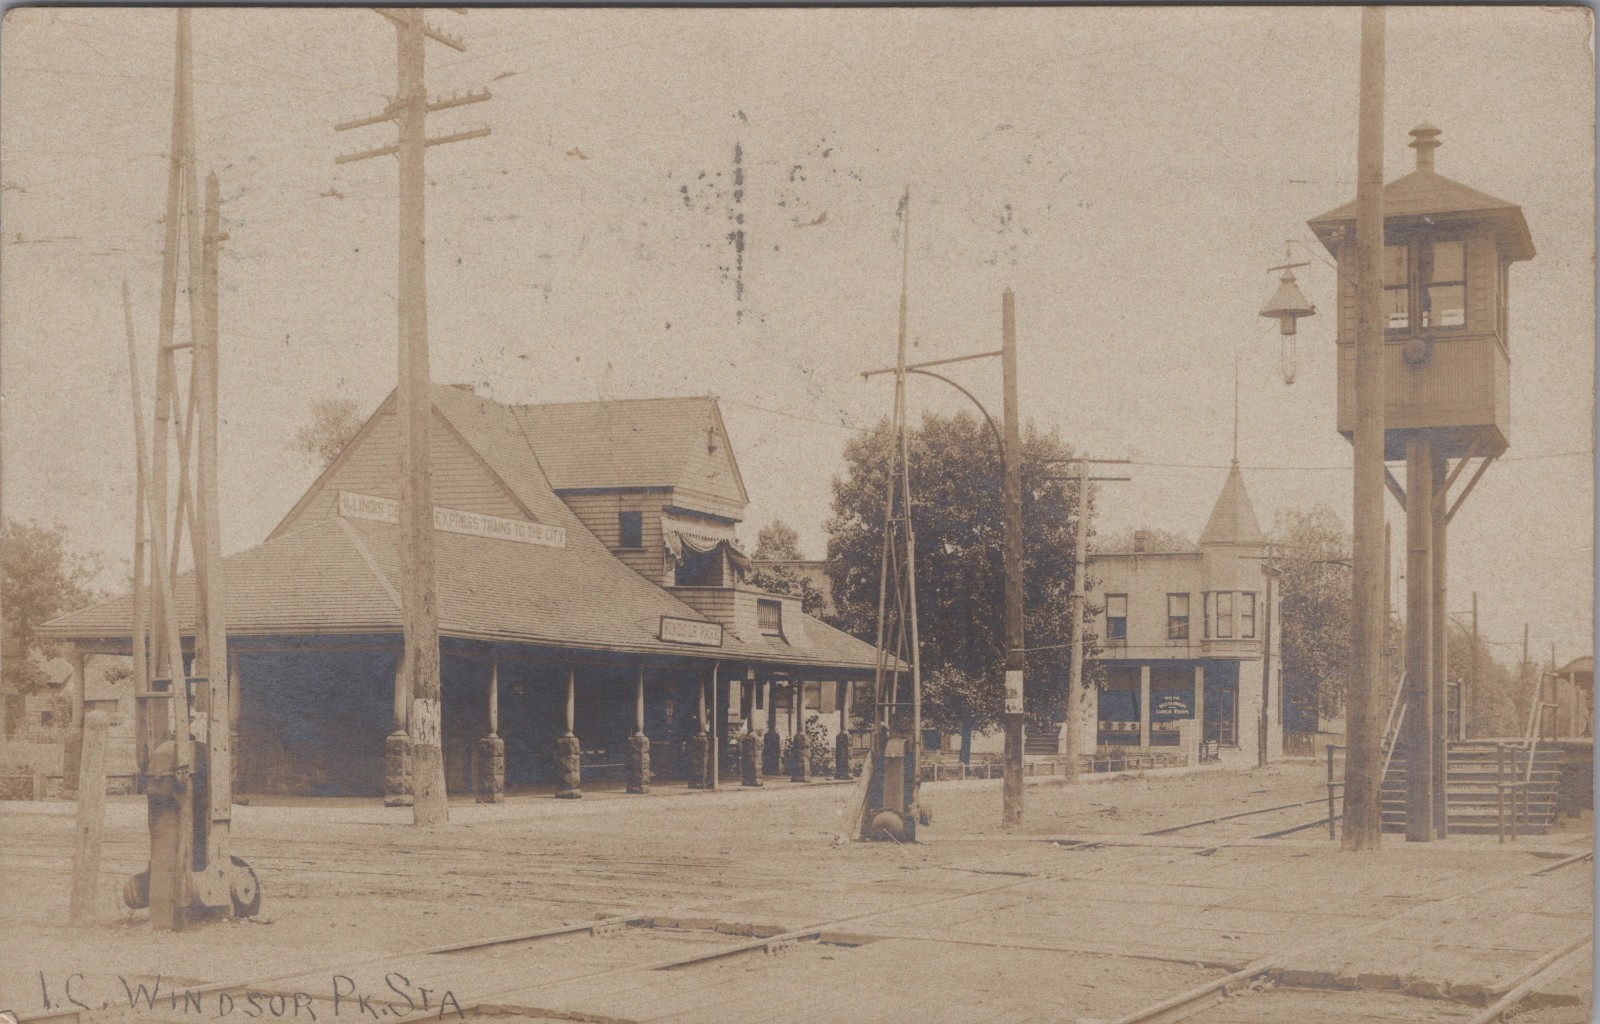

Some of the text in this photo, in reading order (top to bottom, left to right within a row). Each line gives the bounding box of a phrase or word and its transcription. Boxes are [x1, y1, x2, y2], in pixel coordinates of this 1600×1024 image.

[435, 510, 479, 531] EXPRESS
[482, 517, 511, 535] TRAINS
[514, 523, 525, 537] TO
[527, 525, 542, 540] THE
[545, 528, 564, 543] CITY
